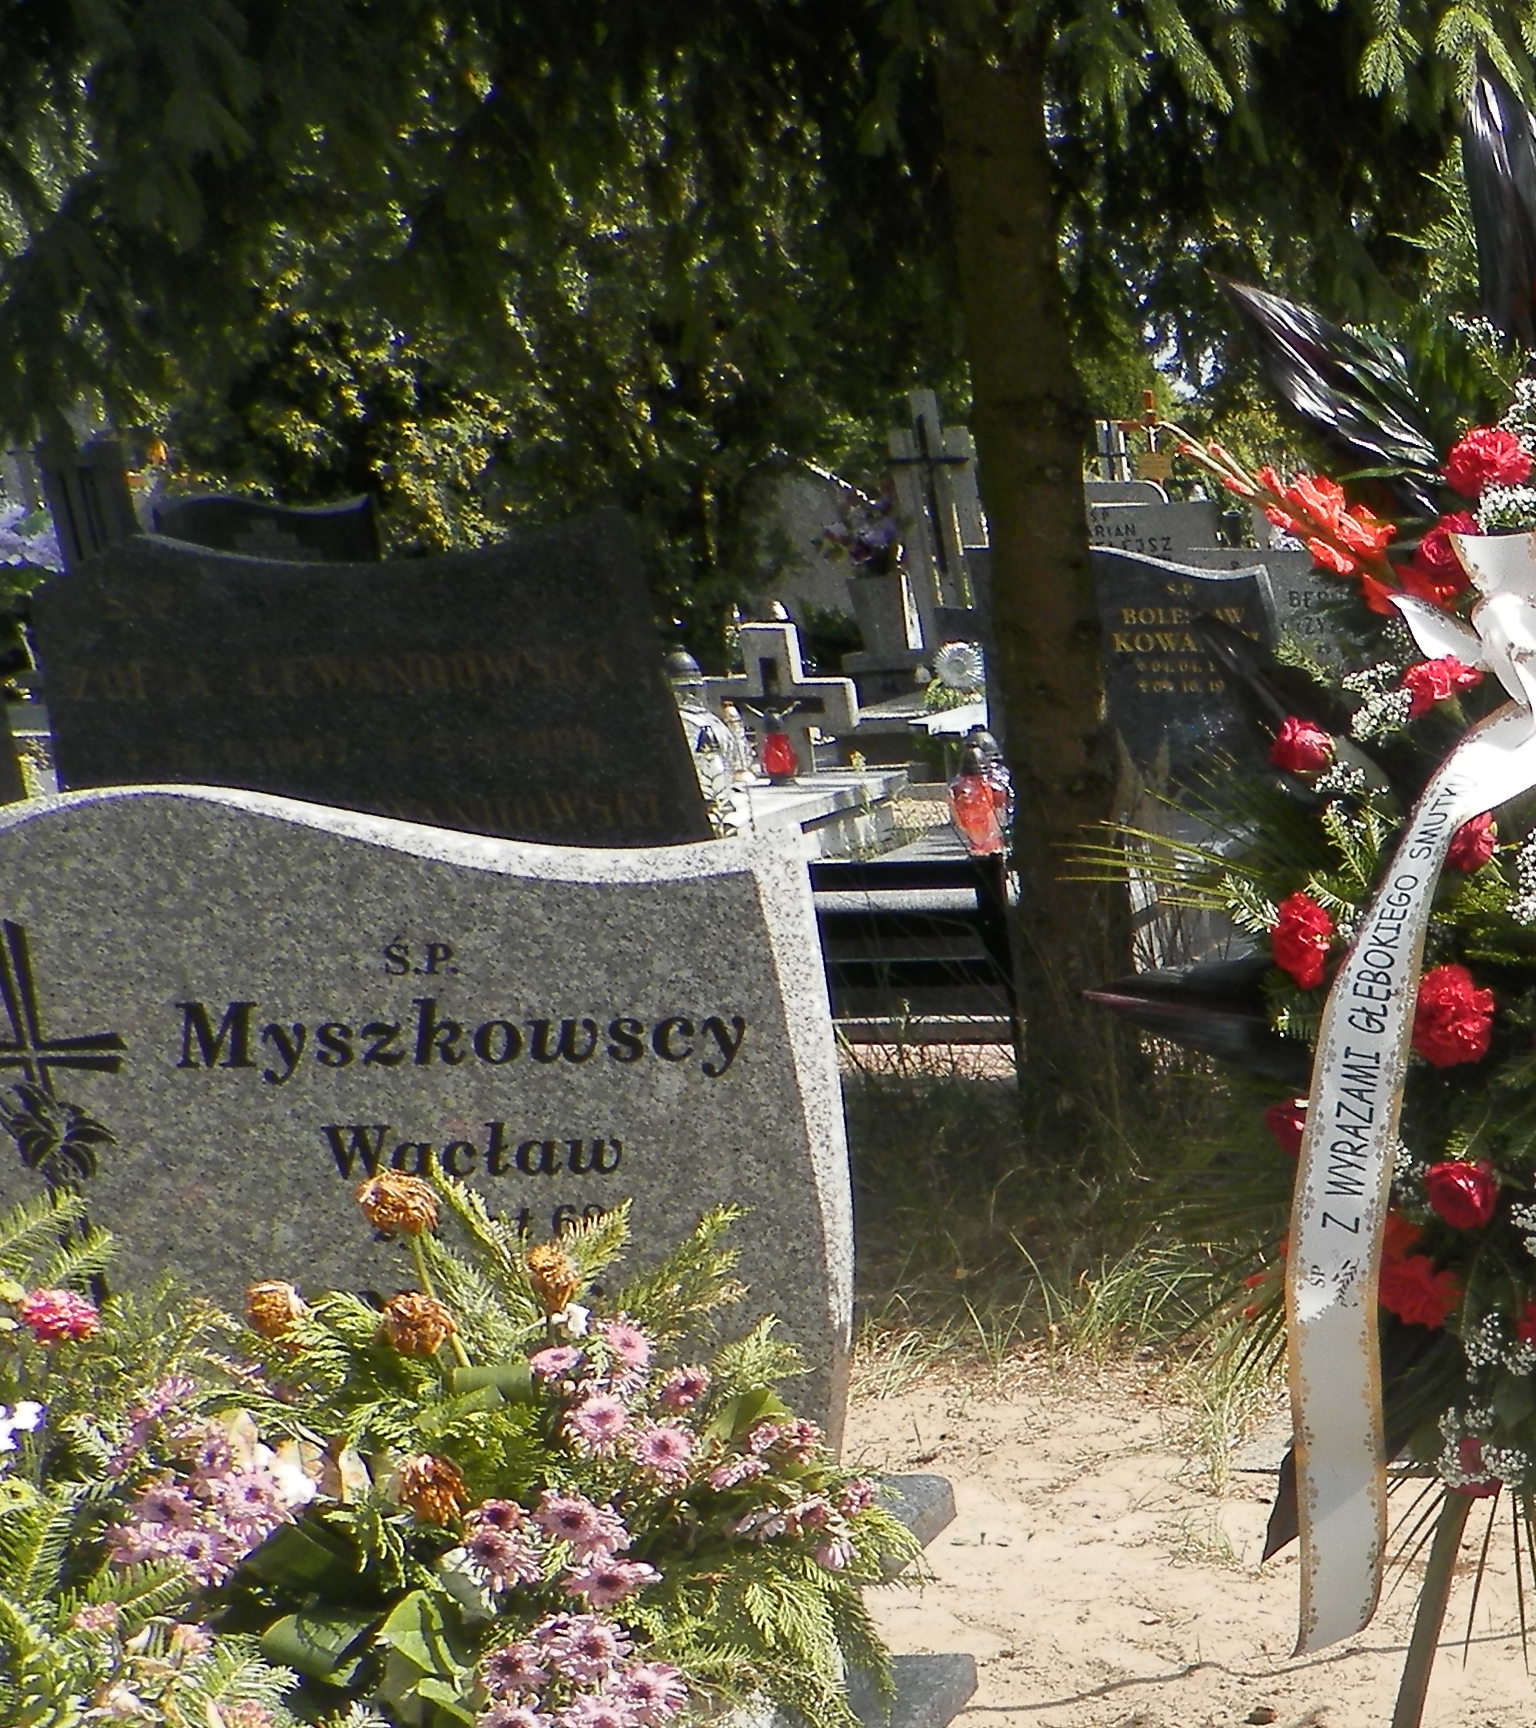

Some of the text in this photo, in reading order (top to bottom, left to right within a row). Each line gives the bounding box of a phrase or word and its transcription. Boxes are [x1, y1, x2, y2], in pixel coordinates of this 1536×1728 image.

[174, 999, 747, 1085] Myszkowscy
[322, 1121, 625, 1180] Wacław
[1325, 1046, 1381, 1197] WYRAZAMI
[1320, 1211, 1362, 1235] Z
